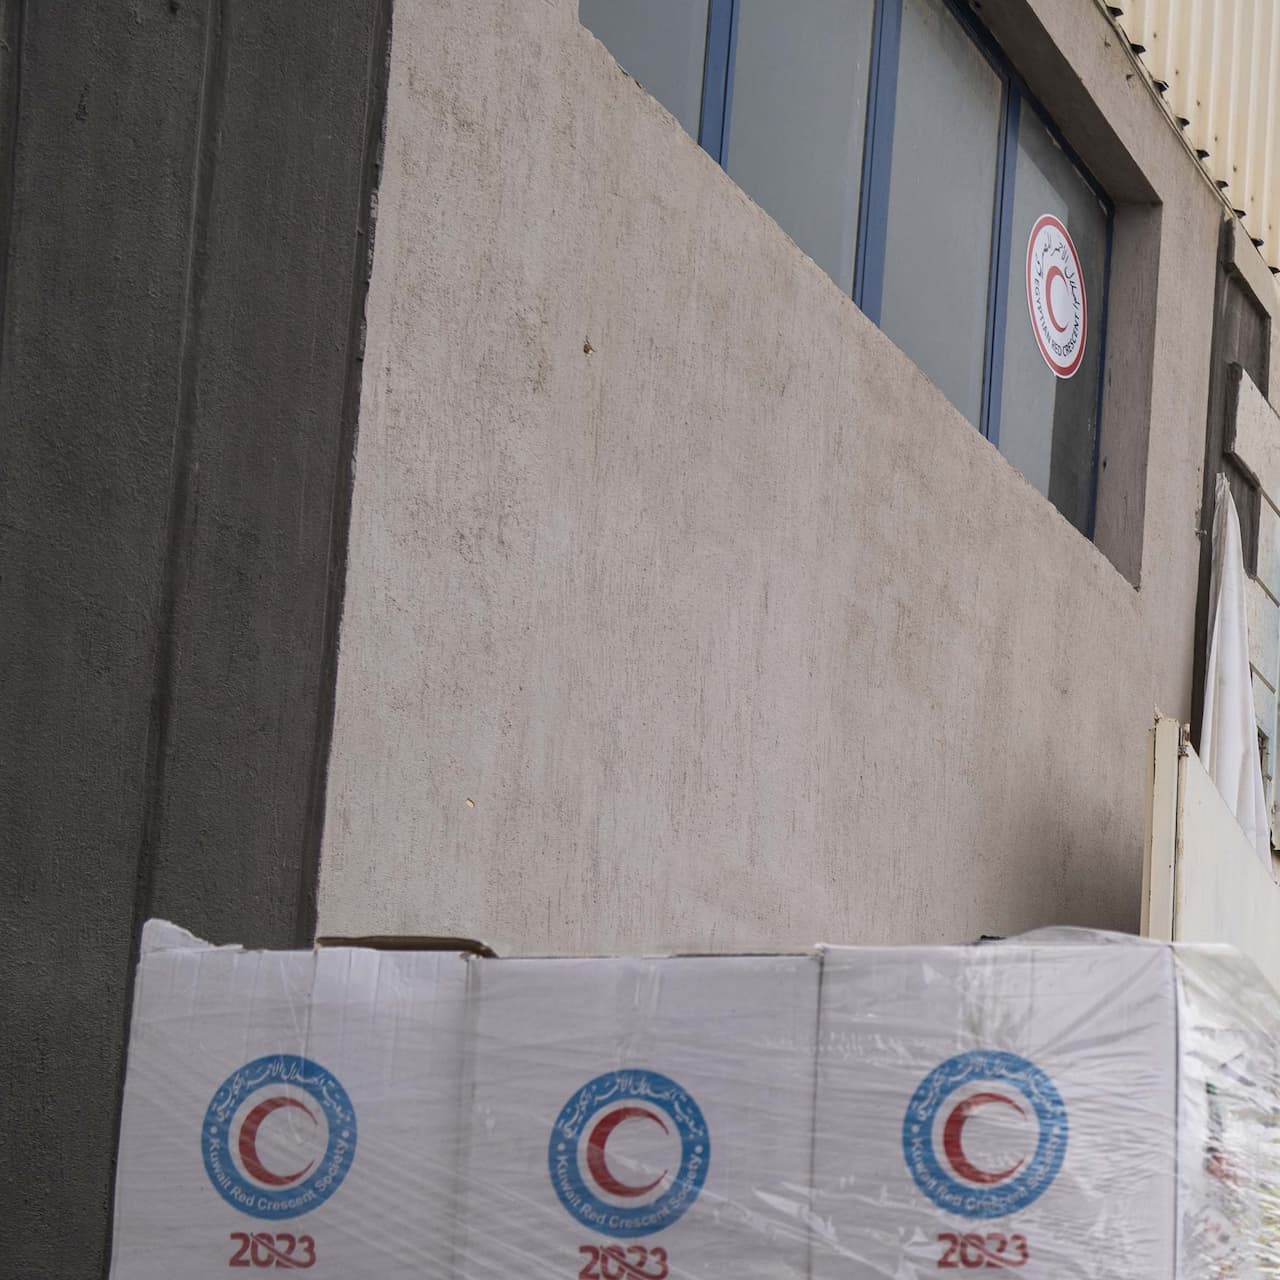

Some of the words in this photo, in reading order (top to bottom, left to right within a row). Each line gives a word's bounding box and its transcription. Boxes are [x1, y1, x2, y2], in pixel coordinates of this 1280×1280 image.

[230, 1233, 314, 1267] 2023
[579, 1245, 668, 1280] 2023
[937, 1233, 1028, 1268] 2023
